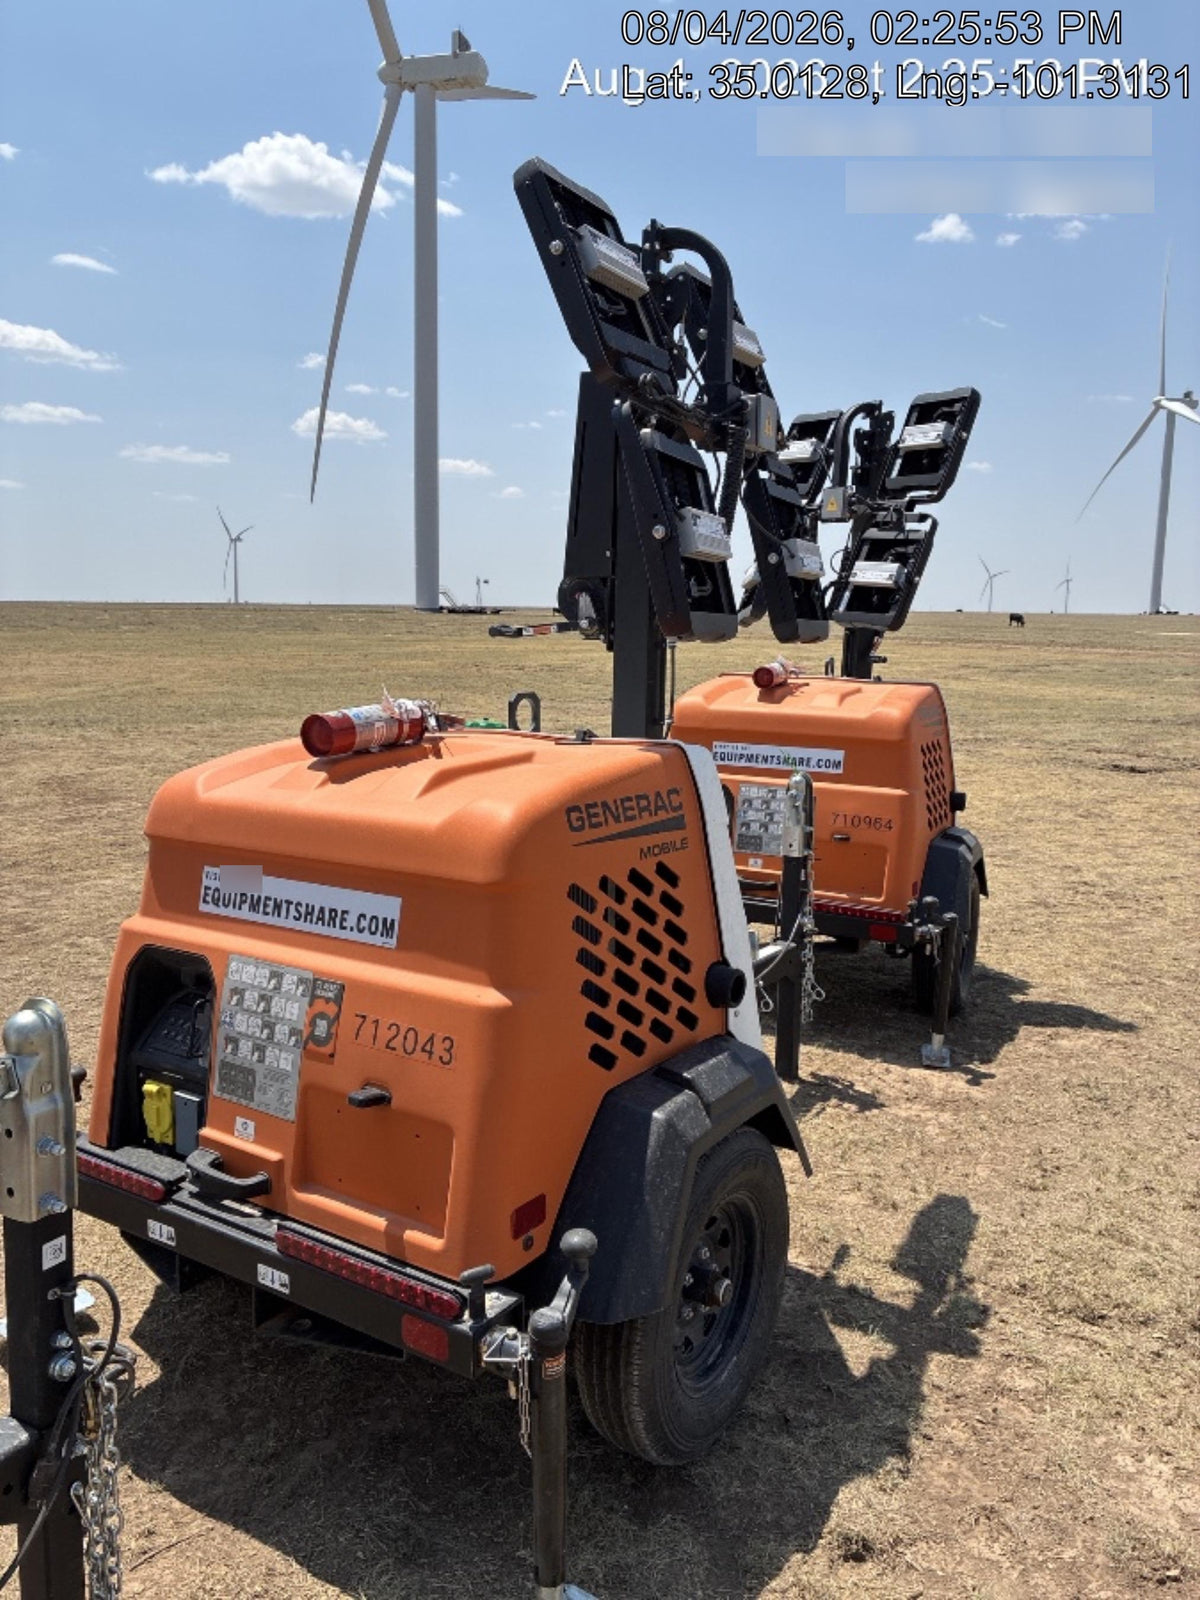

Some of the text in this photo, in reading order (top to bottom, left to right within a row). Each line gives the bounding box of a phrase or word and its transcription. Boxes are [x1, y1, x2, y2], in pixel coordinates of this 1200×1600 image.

[712, 751, 842, 770] EQUIPMENTSHARE.COM
[565, 787, 683, 832] GENERAC
[831, 812, 894, 832] 710964
[639, 837, 689, 861] MOBILE
[202, 884, 397, 940] EQUIPMENTSHARE.COM
[354, 1013, 455, 1066] 712043
